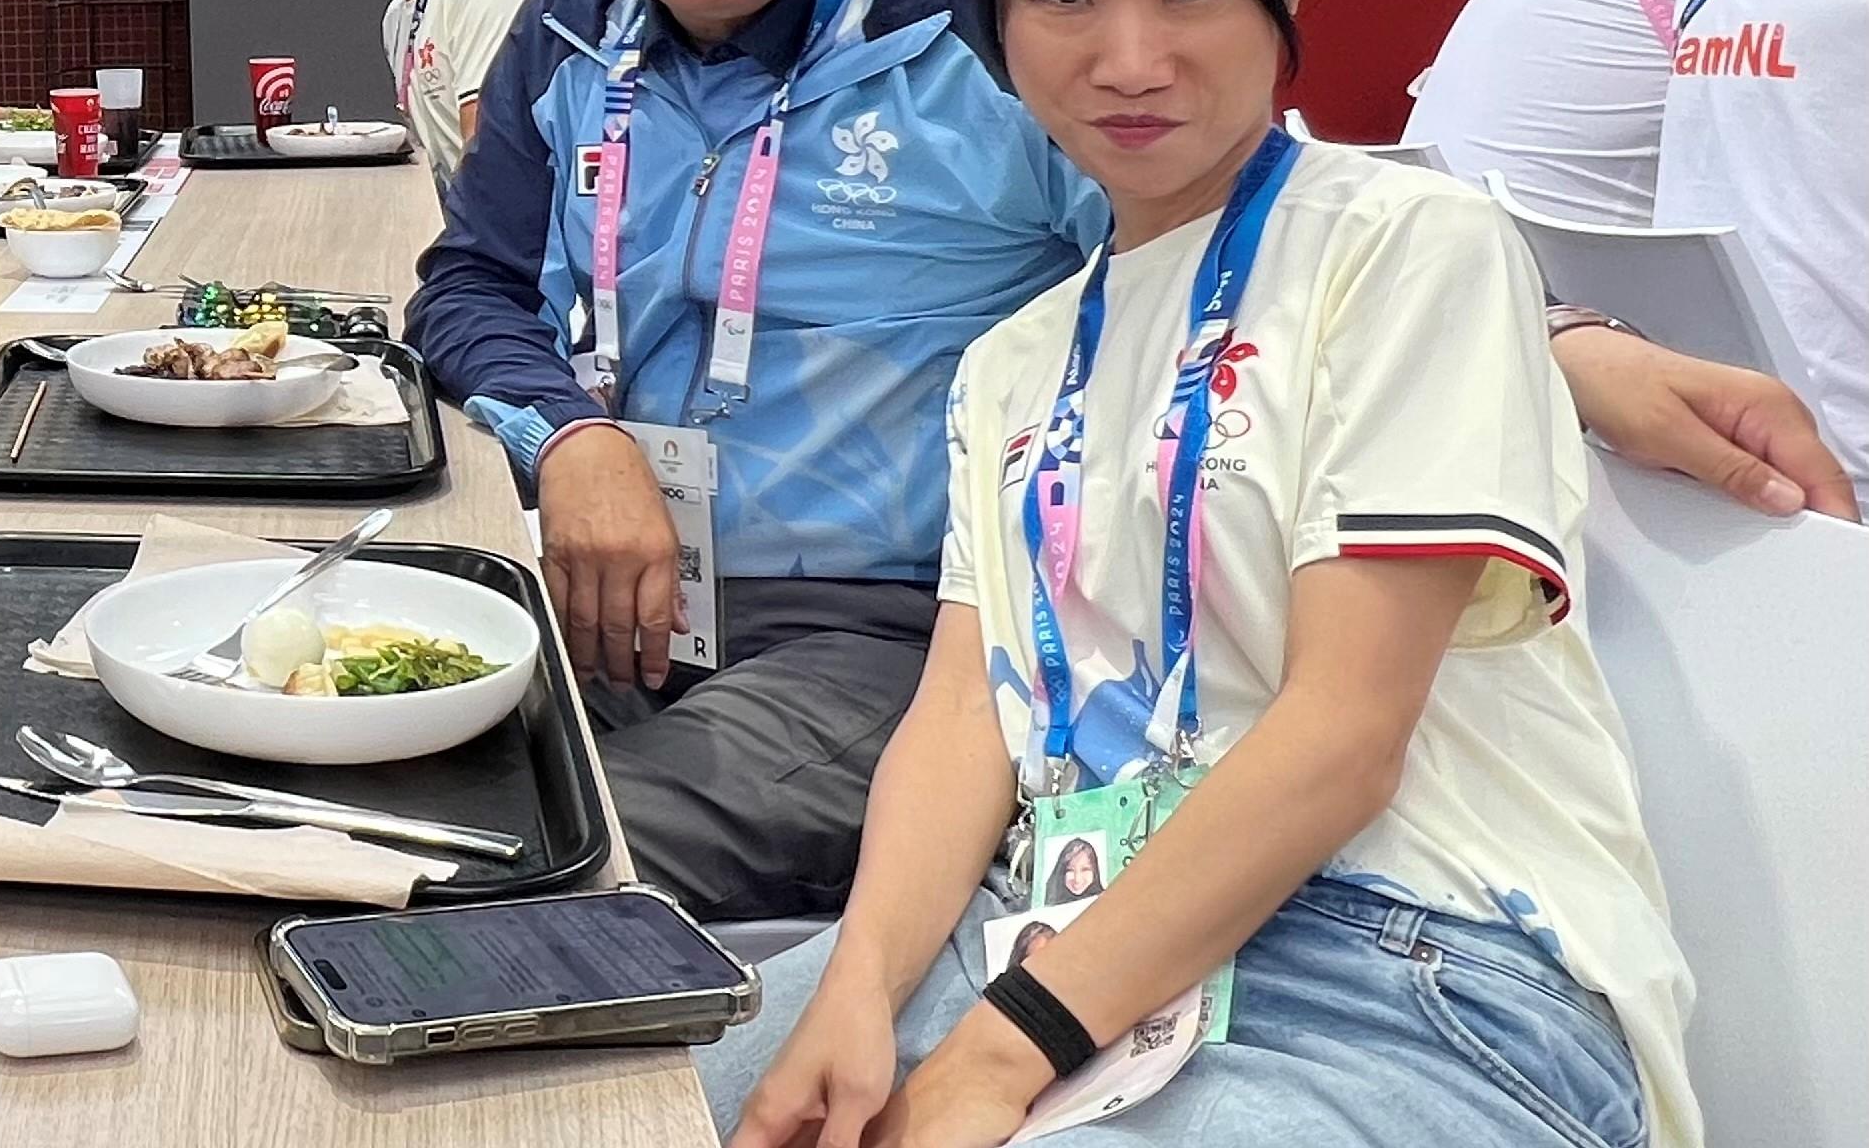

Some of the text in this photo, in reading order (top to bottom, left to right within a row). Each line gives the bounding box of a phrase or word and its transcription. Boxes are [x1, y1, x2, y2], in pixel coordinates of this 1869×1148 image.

[730, 168, 768, 303] PARIS 2024
[1168, 494, 1185, 617] PARIS 2024
[694, 636, 707, 658] R
[1034, 609, 1058, 667] PARIS
